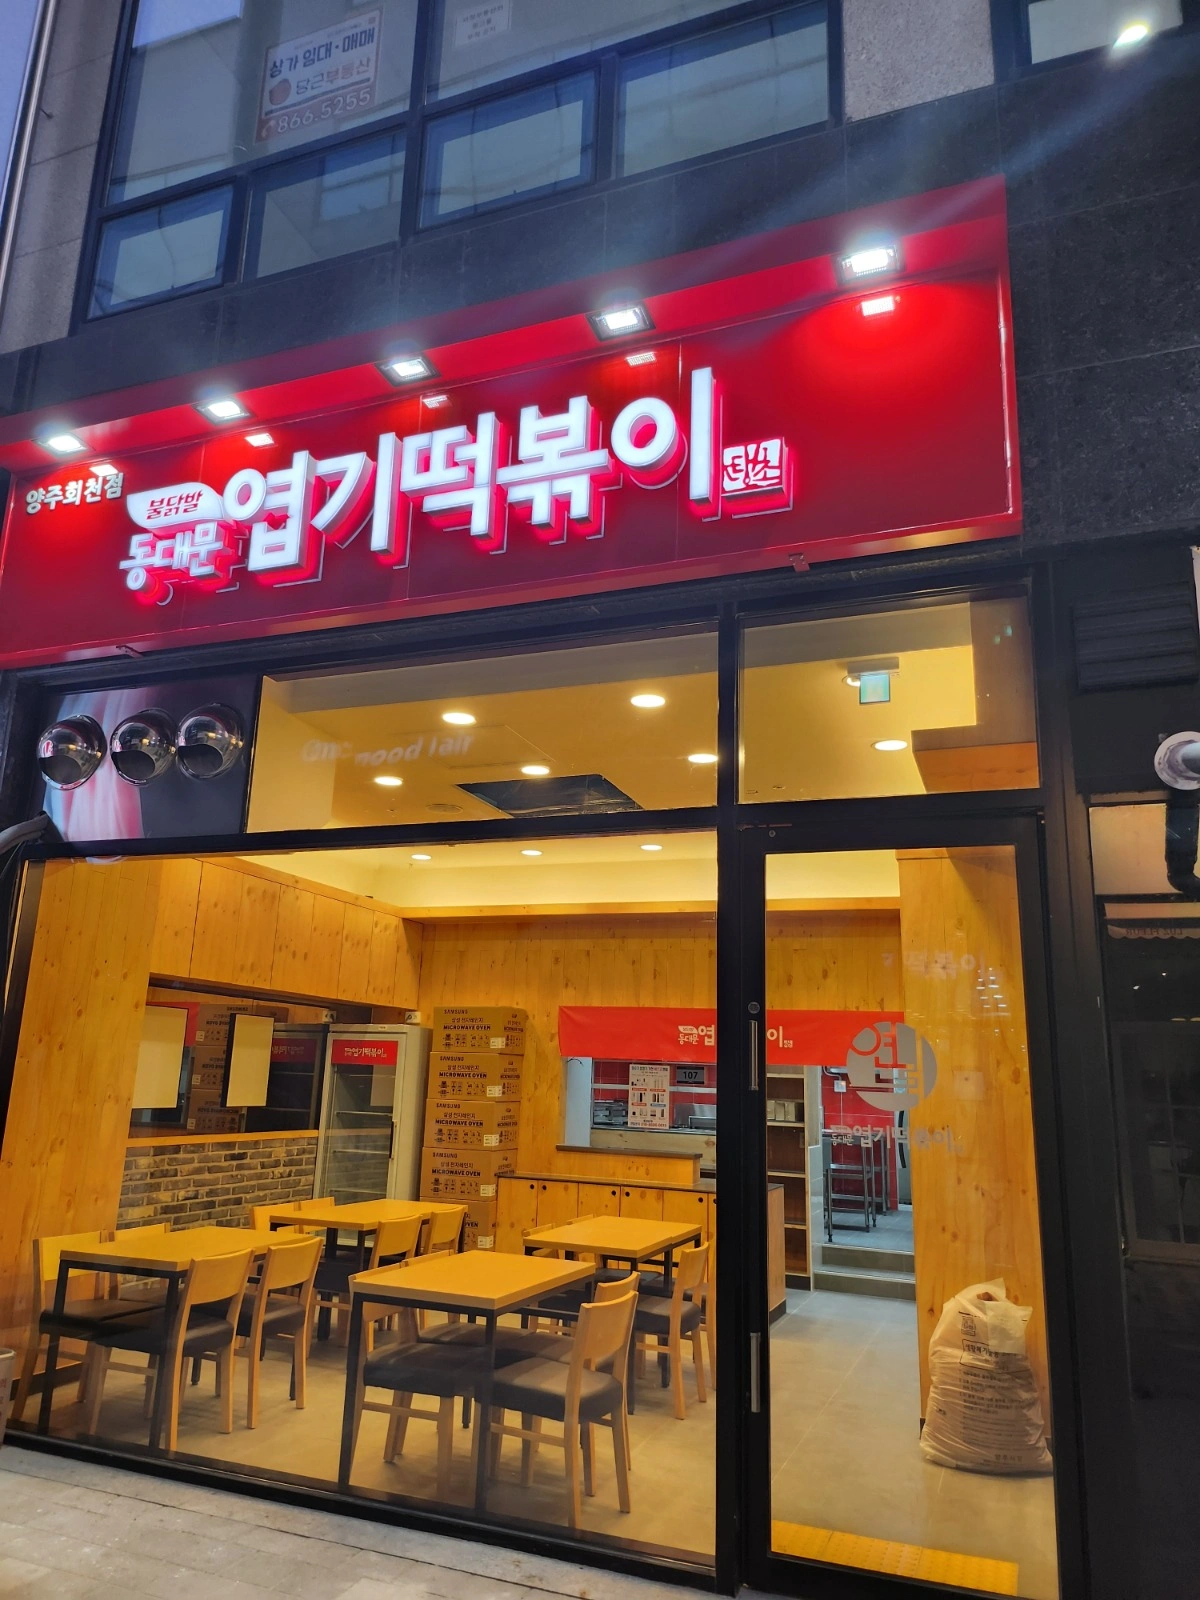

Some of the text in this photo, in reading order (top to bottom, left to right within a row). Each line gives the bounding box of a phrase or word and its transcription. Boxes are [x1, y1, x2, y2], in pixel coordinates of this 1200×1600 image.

[270, 55, 299, 78] 상가
[296, 56, 372, 95] 당근부동산
[277, 88, 371, 132] 866.5255
[26, 472, 124, 514] 양주회천점
[119, 521, 223, 591] 동대문
[223, 366, 713, 571] 엽기떡볶이
[146, 489, 204, 520] 불닭발
[678, 1034, 699, 1045] 동대문
[683, 1071, 699, 1080] 107
[431, 1168, 465, 1176] MICROWAVE
